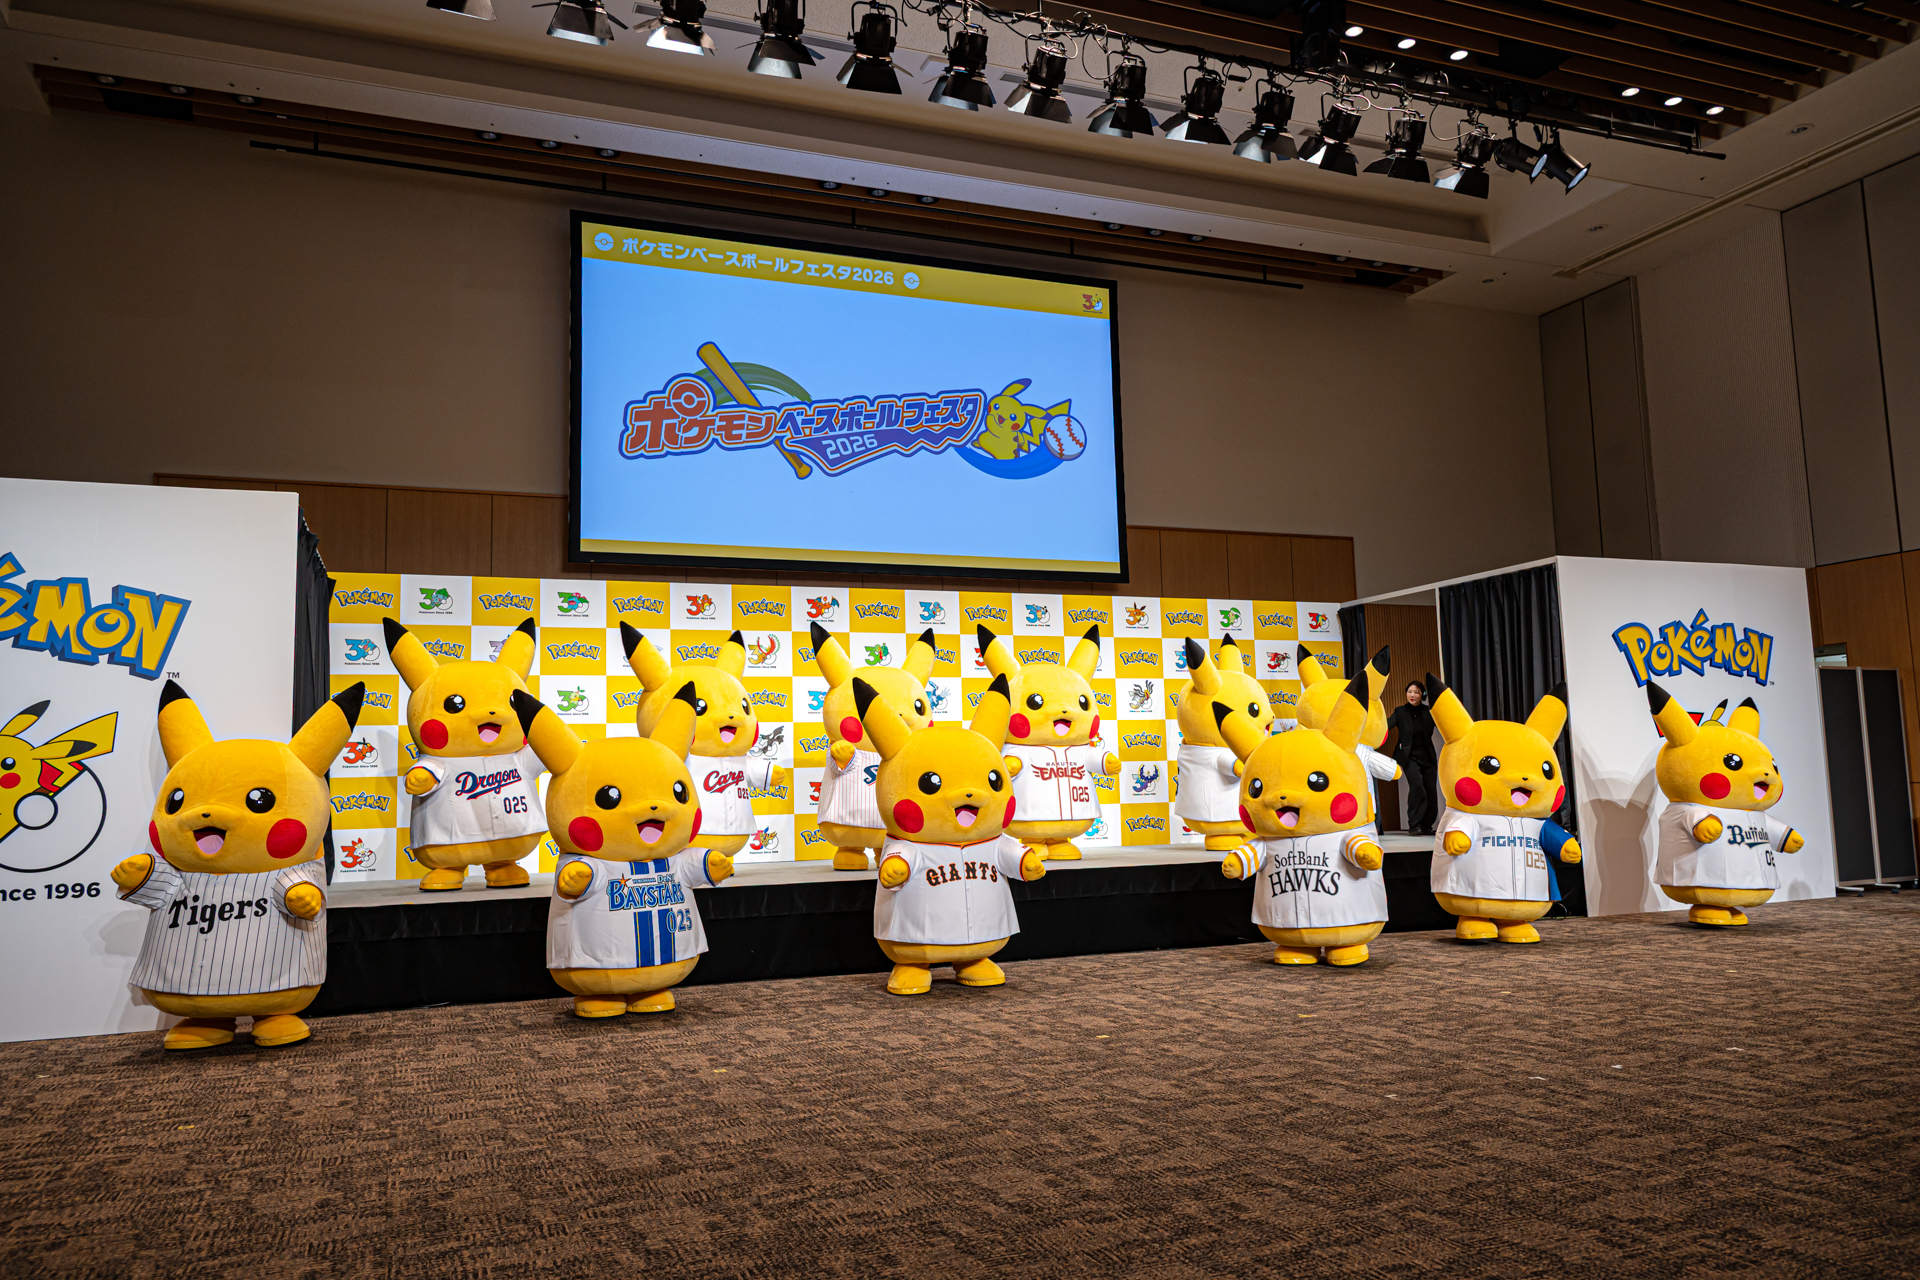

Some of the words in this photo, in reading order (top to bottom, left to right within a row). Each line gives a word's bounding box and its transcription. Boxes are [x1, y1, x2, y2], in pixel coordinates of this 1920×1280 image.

[622, 237, 894, 285] ポケモンベースボールフェスタ2026
[822, 434, 878, 460] 2026
[455, 768, 522, 800] Dragons
[703, 770, 744, 794] Carp
[1036, 765, 1085, 781] EAGLES
[503, 796, 528, 814] 025
[1072, 786, 1090, 802] 025
[1274, 851, 1329, 869] SoftBank
[926, 861, 998, 887] GIANTS
[1268, 868, 1341, 898] HAWKS
[44, 882, 101, 900] 1996
[606, 878, 685, 911] BAYSTARS
[168, 894, 268, 934] Tigers
[667, 908, 693, 933] 025
